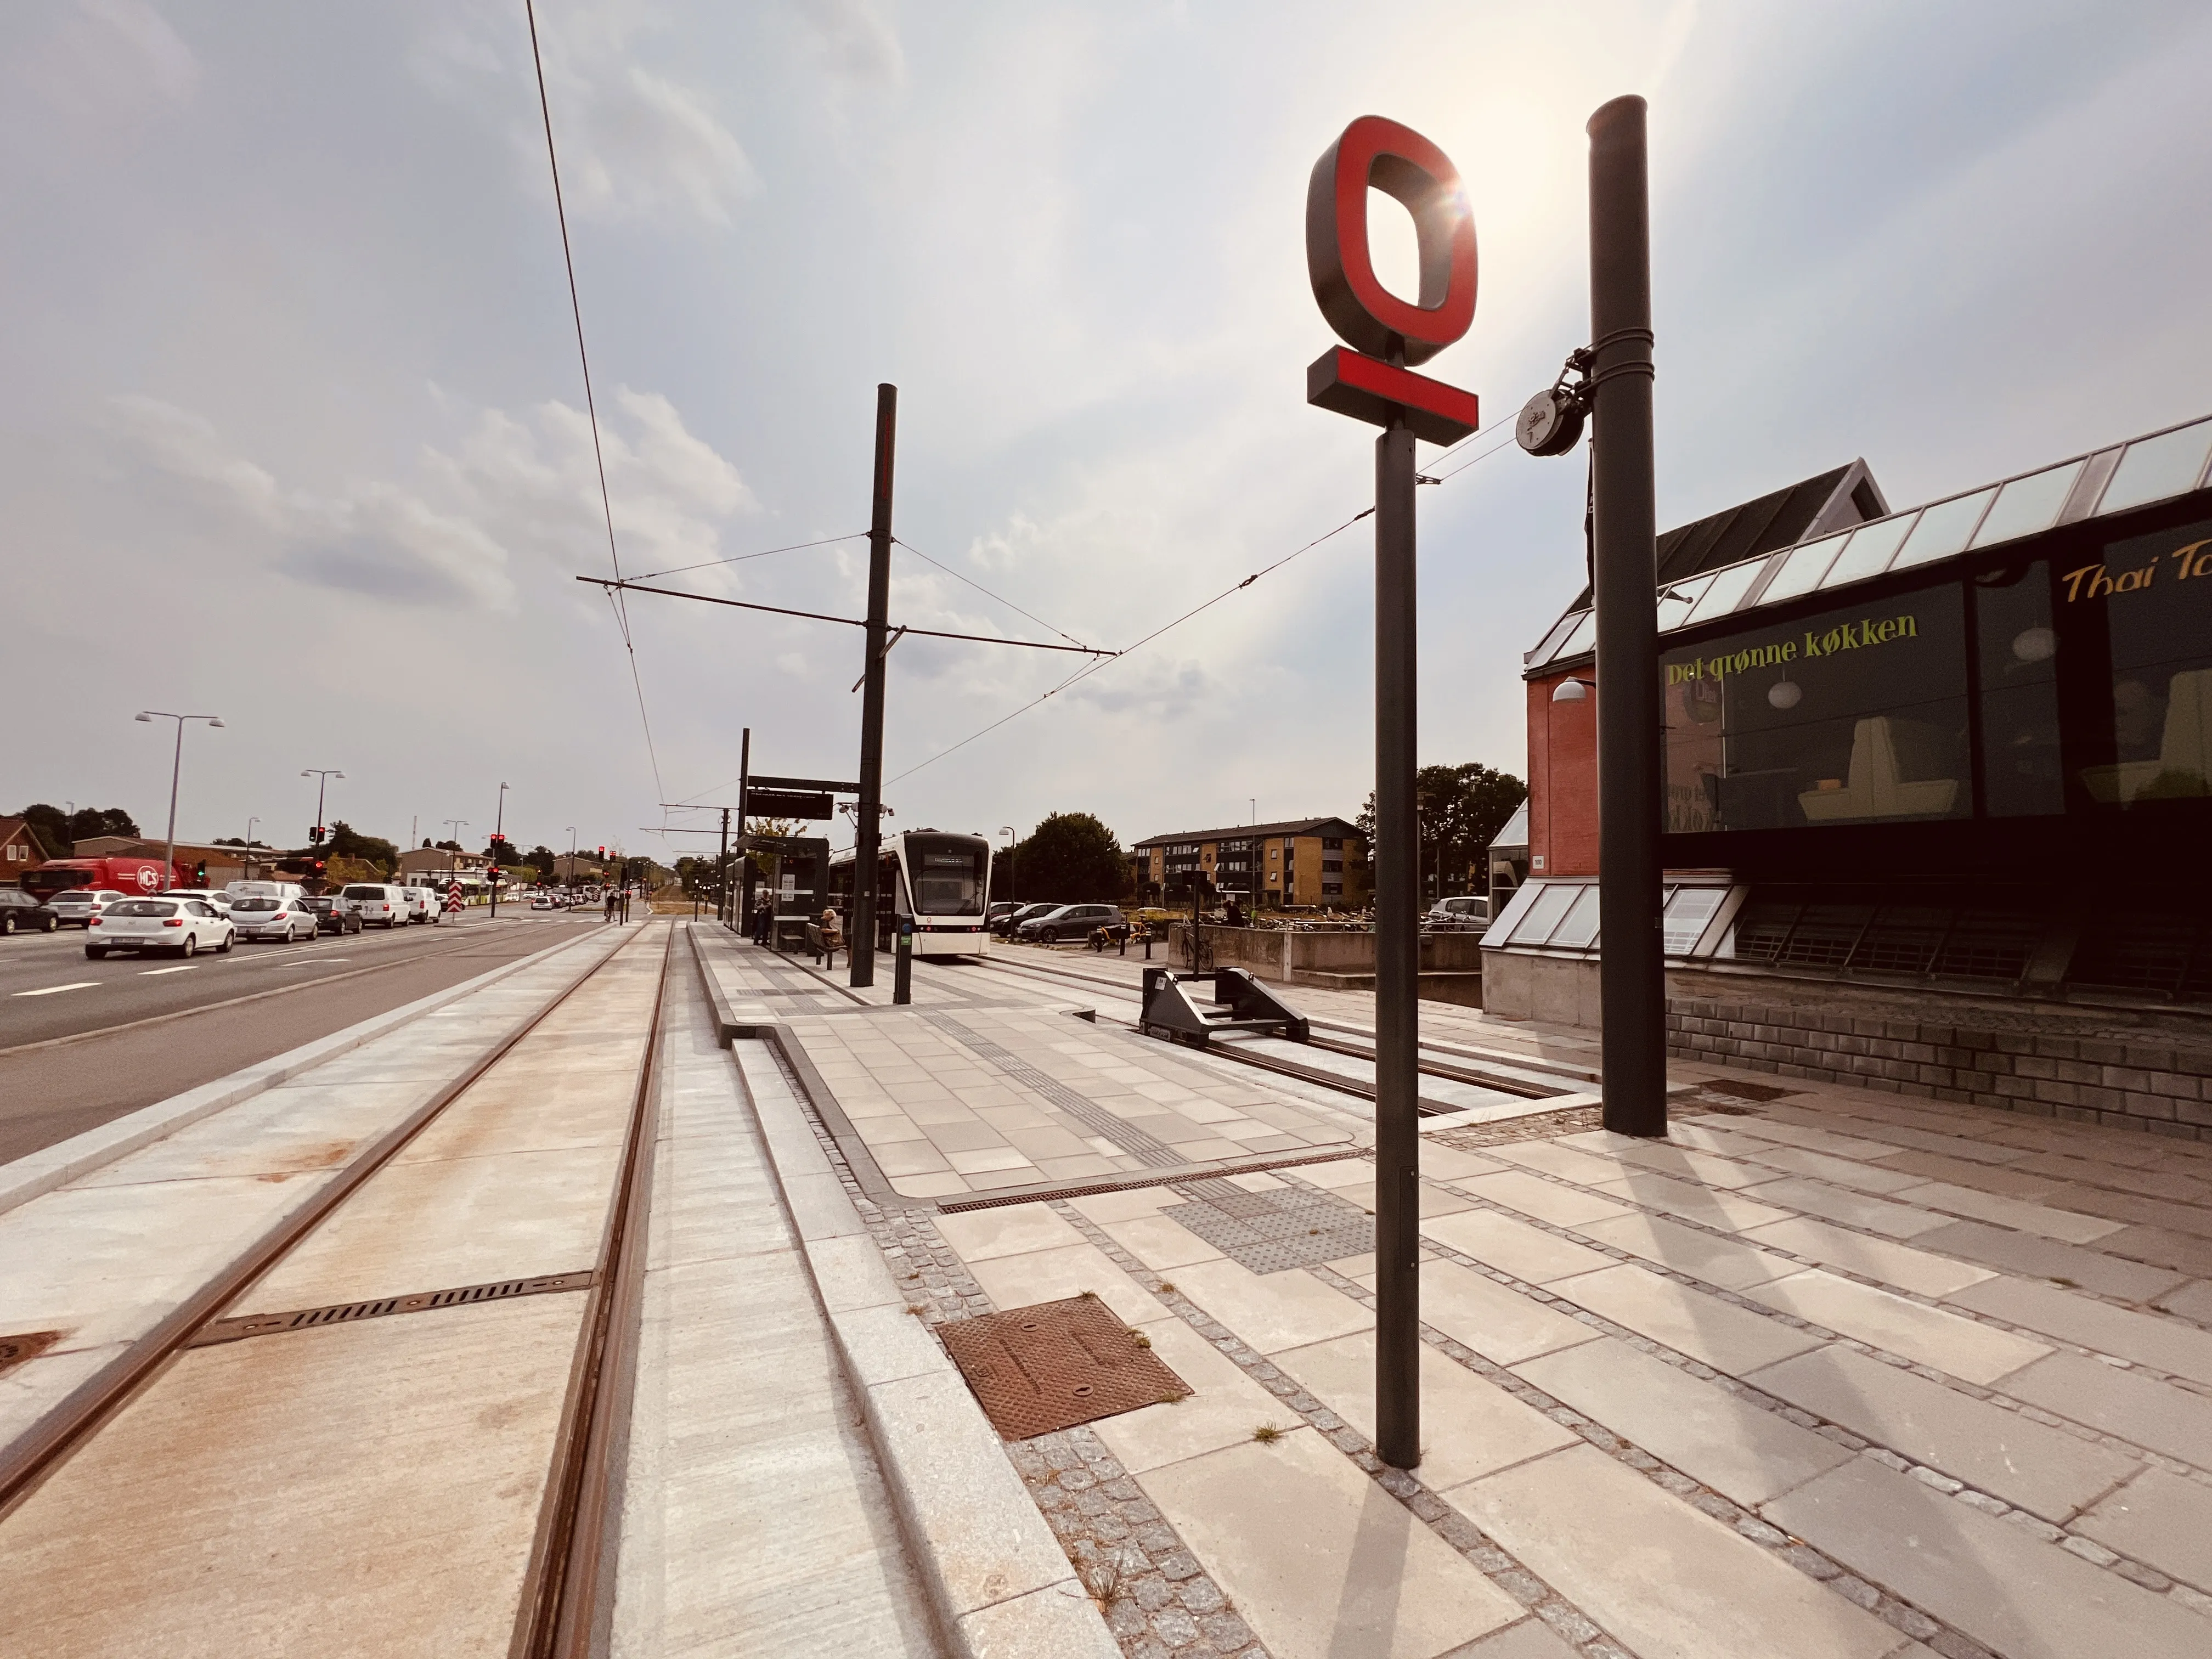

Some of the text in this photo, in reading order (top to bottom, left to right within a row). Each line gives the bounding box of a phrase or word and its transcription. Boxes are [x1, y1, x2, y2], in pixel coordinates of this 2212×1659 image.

[2062, 556, 2159, 602] Thai
[1667, 614, 1918, 686] Det grønne køkken
[139, 870, 157, 887] HCS
